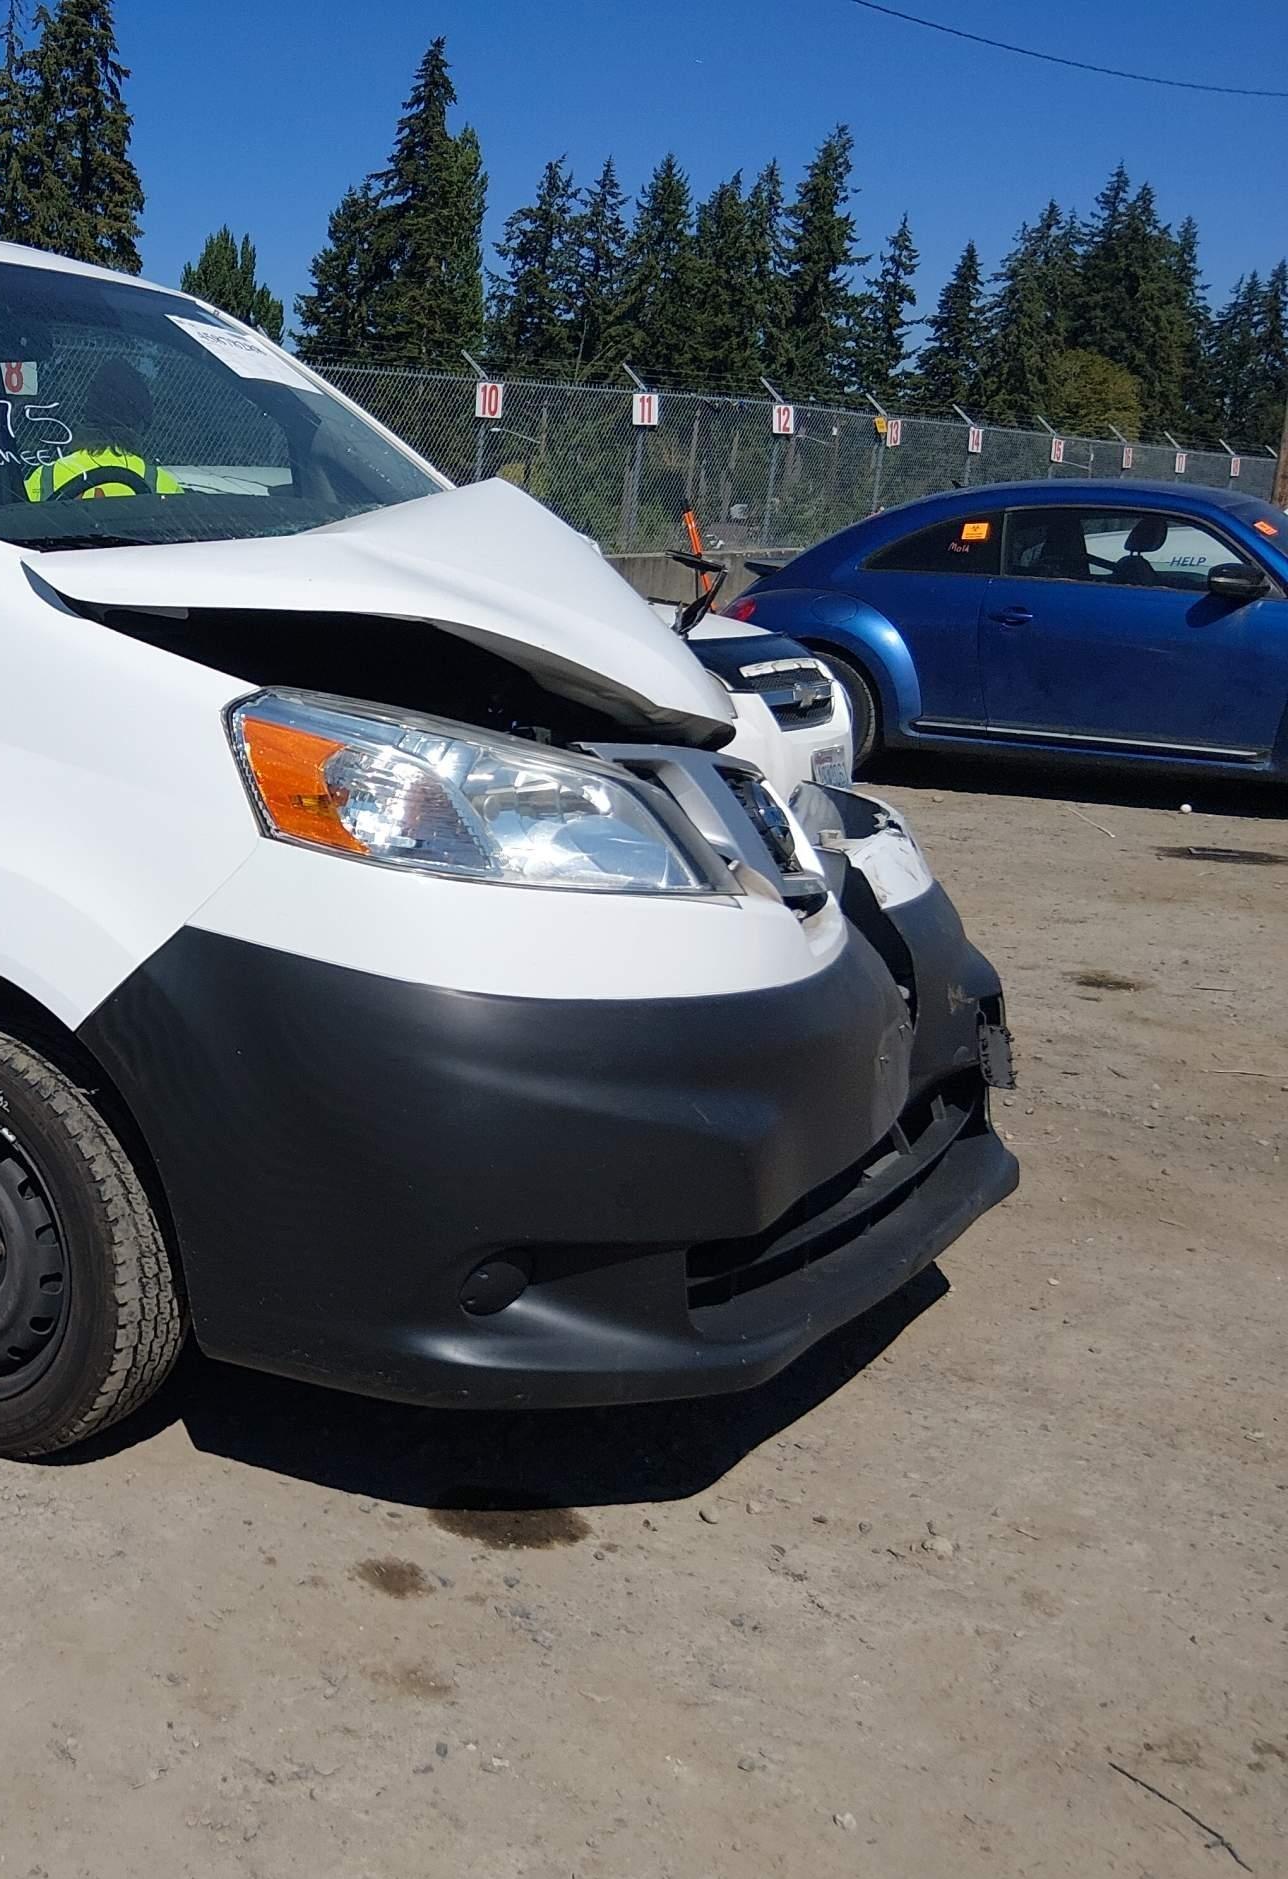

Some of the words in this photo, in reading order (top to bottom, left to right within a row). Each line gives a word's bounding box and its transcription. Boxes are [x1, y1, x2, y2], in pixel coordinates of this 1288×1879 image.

[480, 384, 499, 417] 10
[639, 395, 652, 423] 11
[776, 406, 791, 432] 12
[889, 421, 900, 445] 13
[971, 429, 981, 451] 14
[1053, 440, 1062, 461] 15
[1170, 556, 1207, 567] HELP
